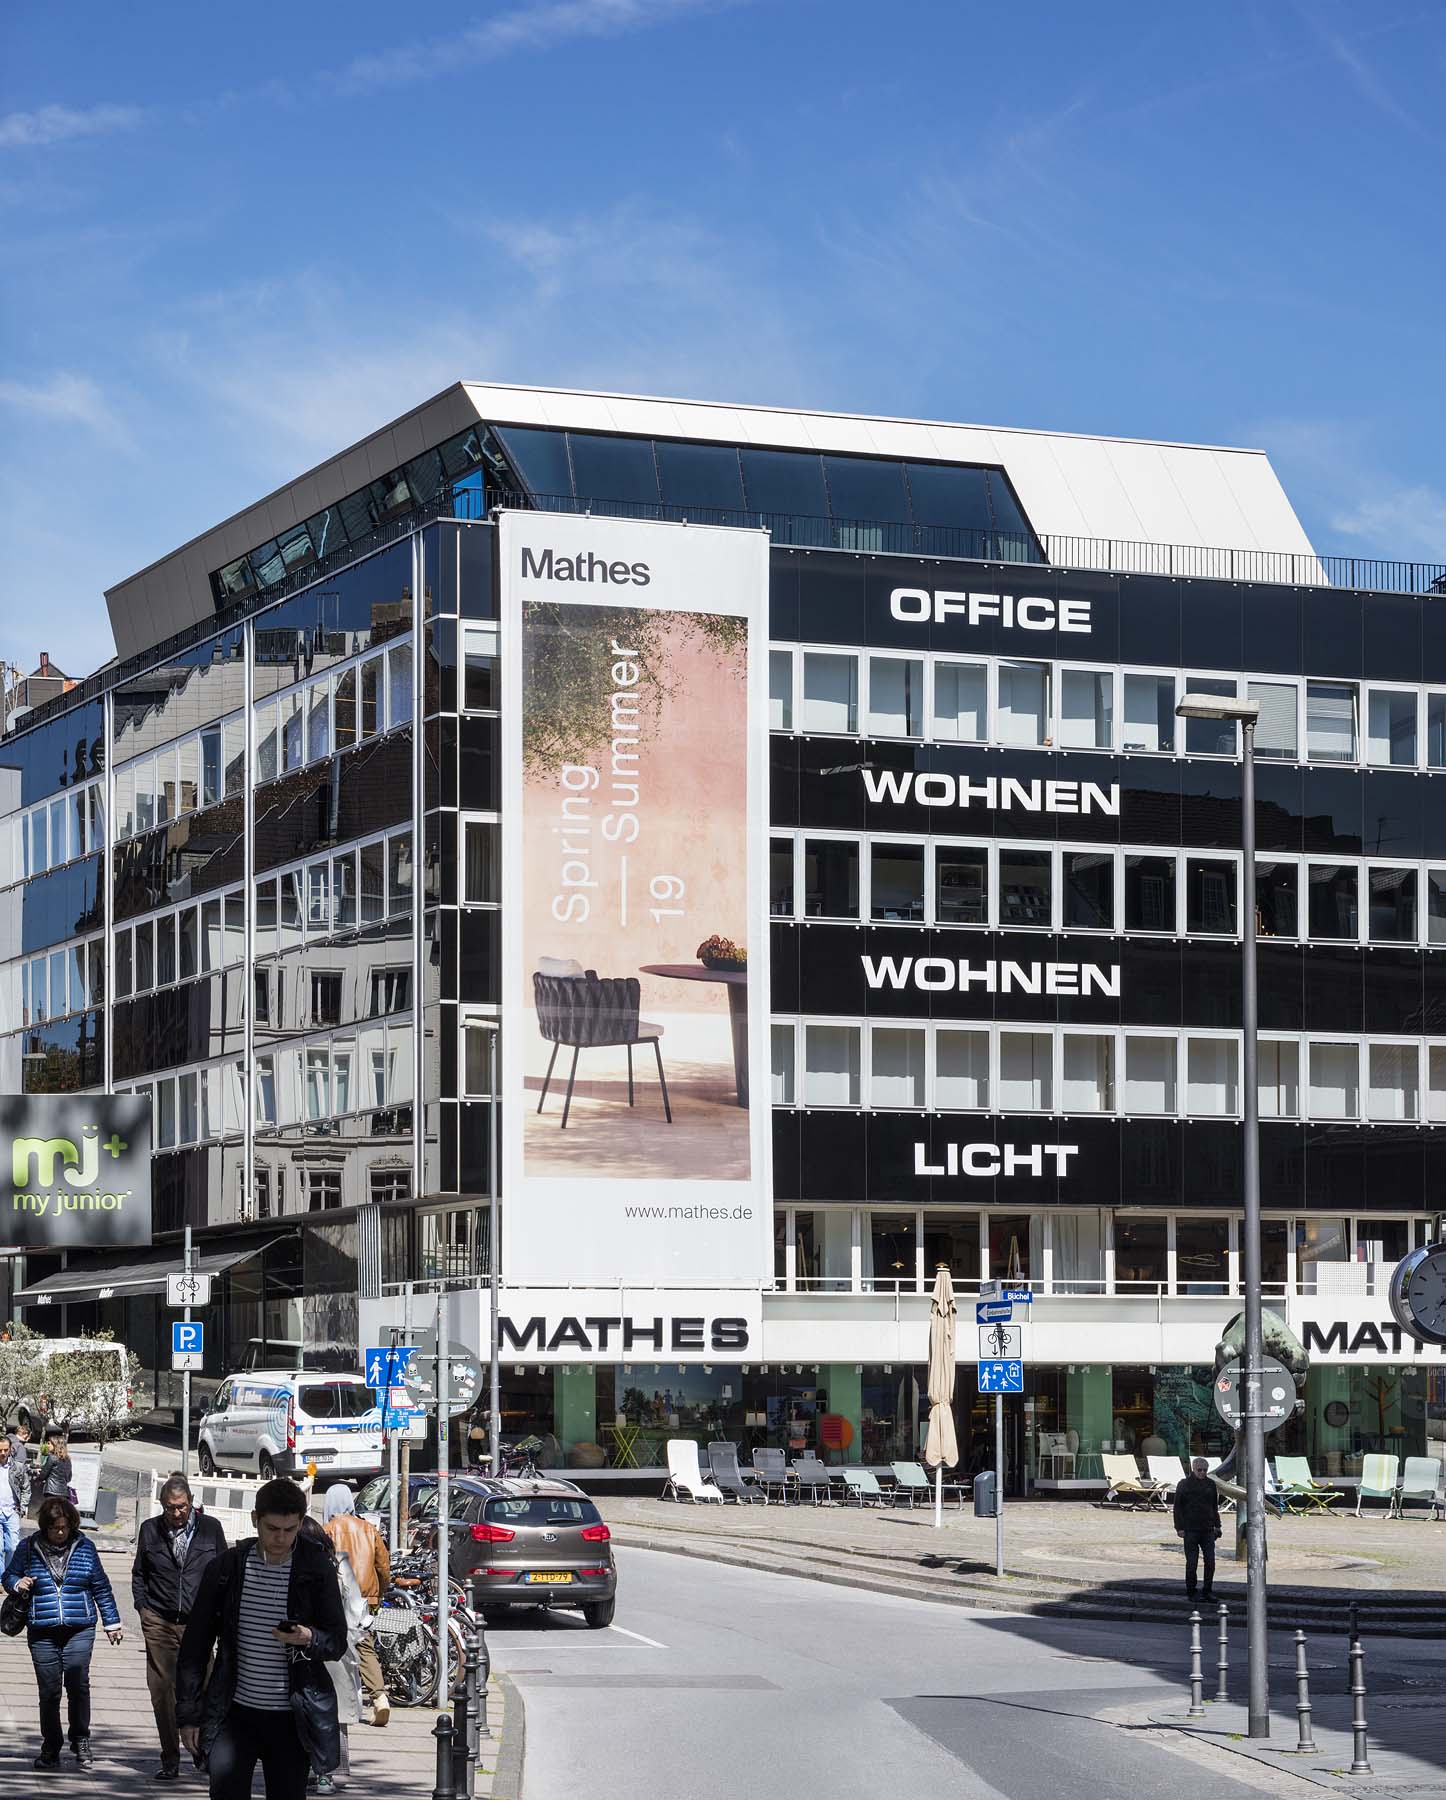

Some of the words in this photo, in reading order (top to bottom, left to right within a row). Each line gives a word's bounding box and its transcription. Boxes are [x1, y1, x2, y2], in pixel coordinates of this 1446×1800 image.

[522, 548, 650, 587] Mathes
[890, 588, 1092, 634] OFFICE
[601, 640, 640, 843] Summer
[862, 770, 1120, 816] WOHNEN
[552, 764, 600, 924] Spring
[649, 874, 685, 924] 19
[861, 956, 1121, 997] WOHNEN
[914, 1143, 1079, 1177] LICHT
[13, 1193, 51, 1216] my
[52, 1188, 127, 1216] junior
[624, 1203, 753, 1220] www.mathes.de
[180, 1326, 196, 1349] P
[498, 1316, 748, 1349] MATHES
